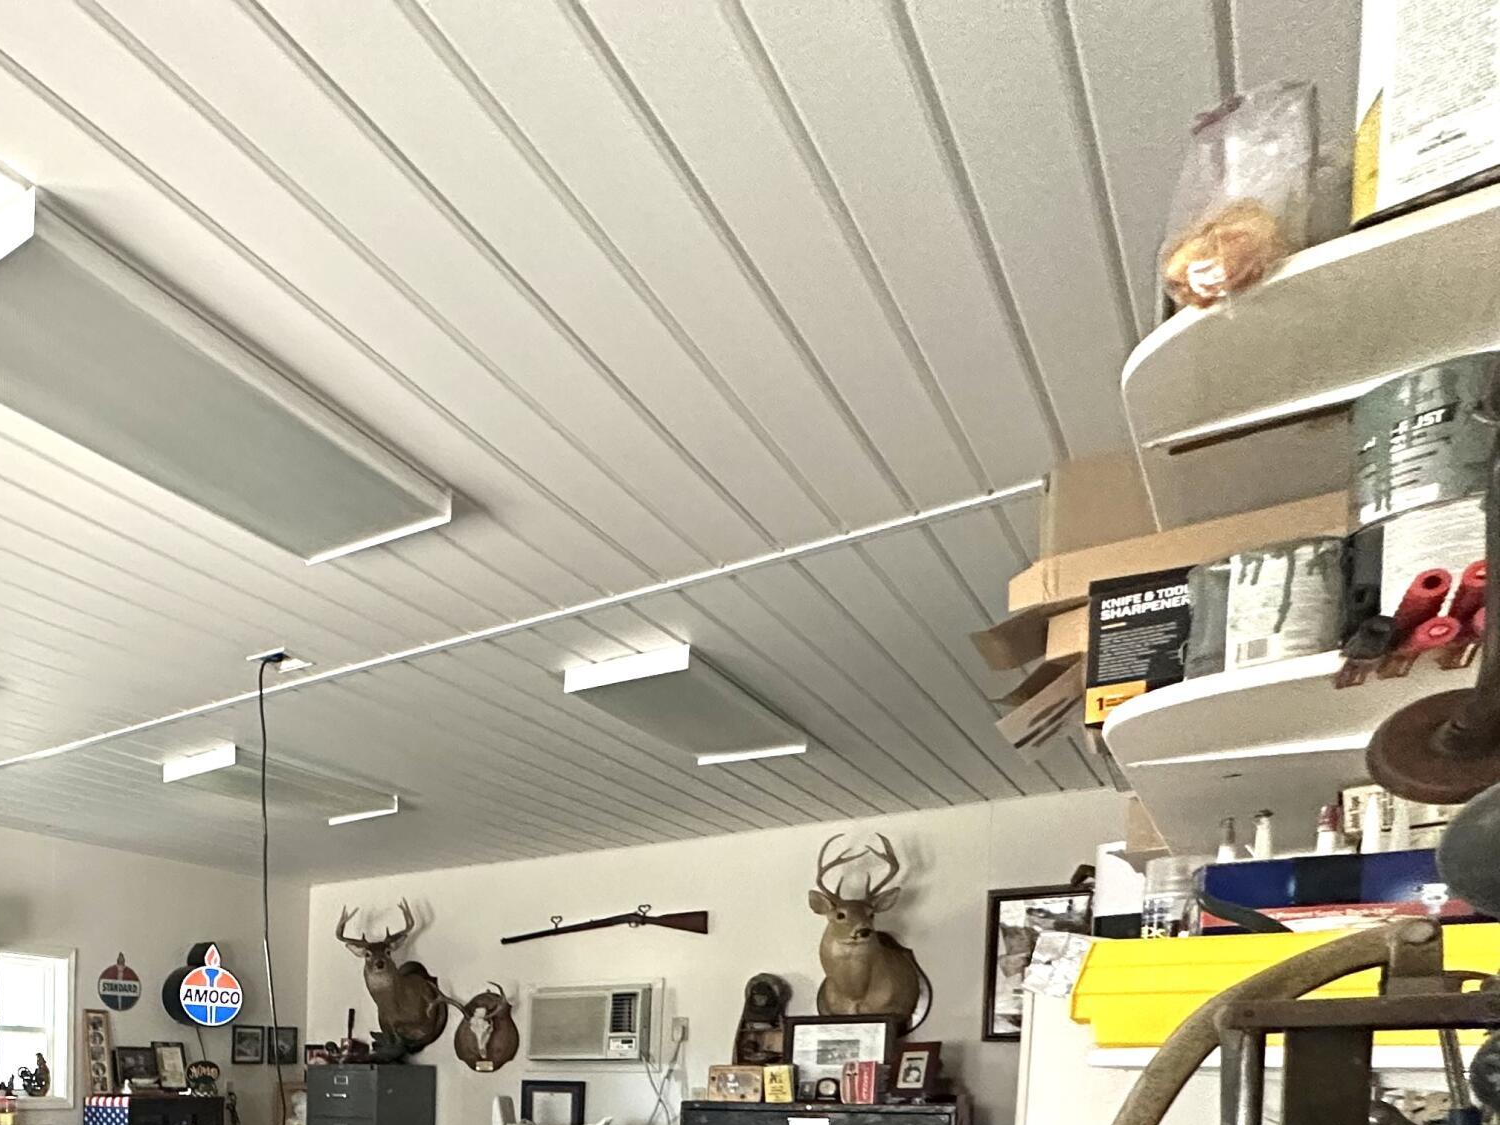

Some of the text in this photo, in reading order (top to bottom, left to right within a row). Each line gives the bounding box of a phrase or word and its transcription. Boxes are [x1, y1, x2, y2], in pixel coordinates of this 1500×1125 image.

[1100, 595, 1191, 621] SHARPENER
[1101, 592, 1142, 611] KNIFE
[102, 982, 138, 994] STANDARD
[183, 988, 240, 1005] AMOCO
